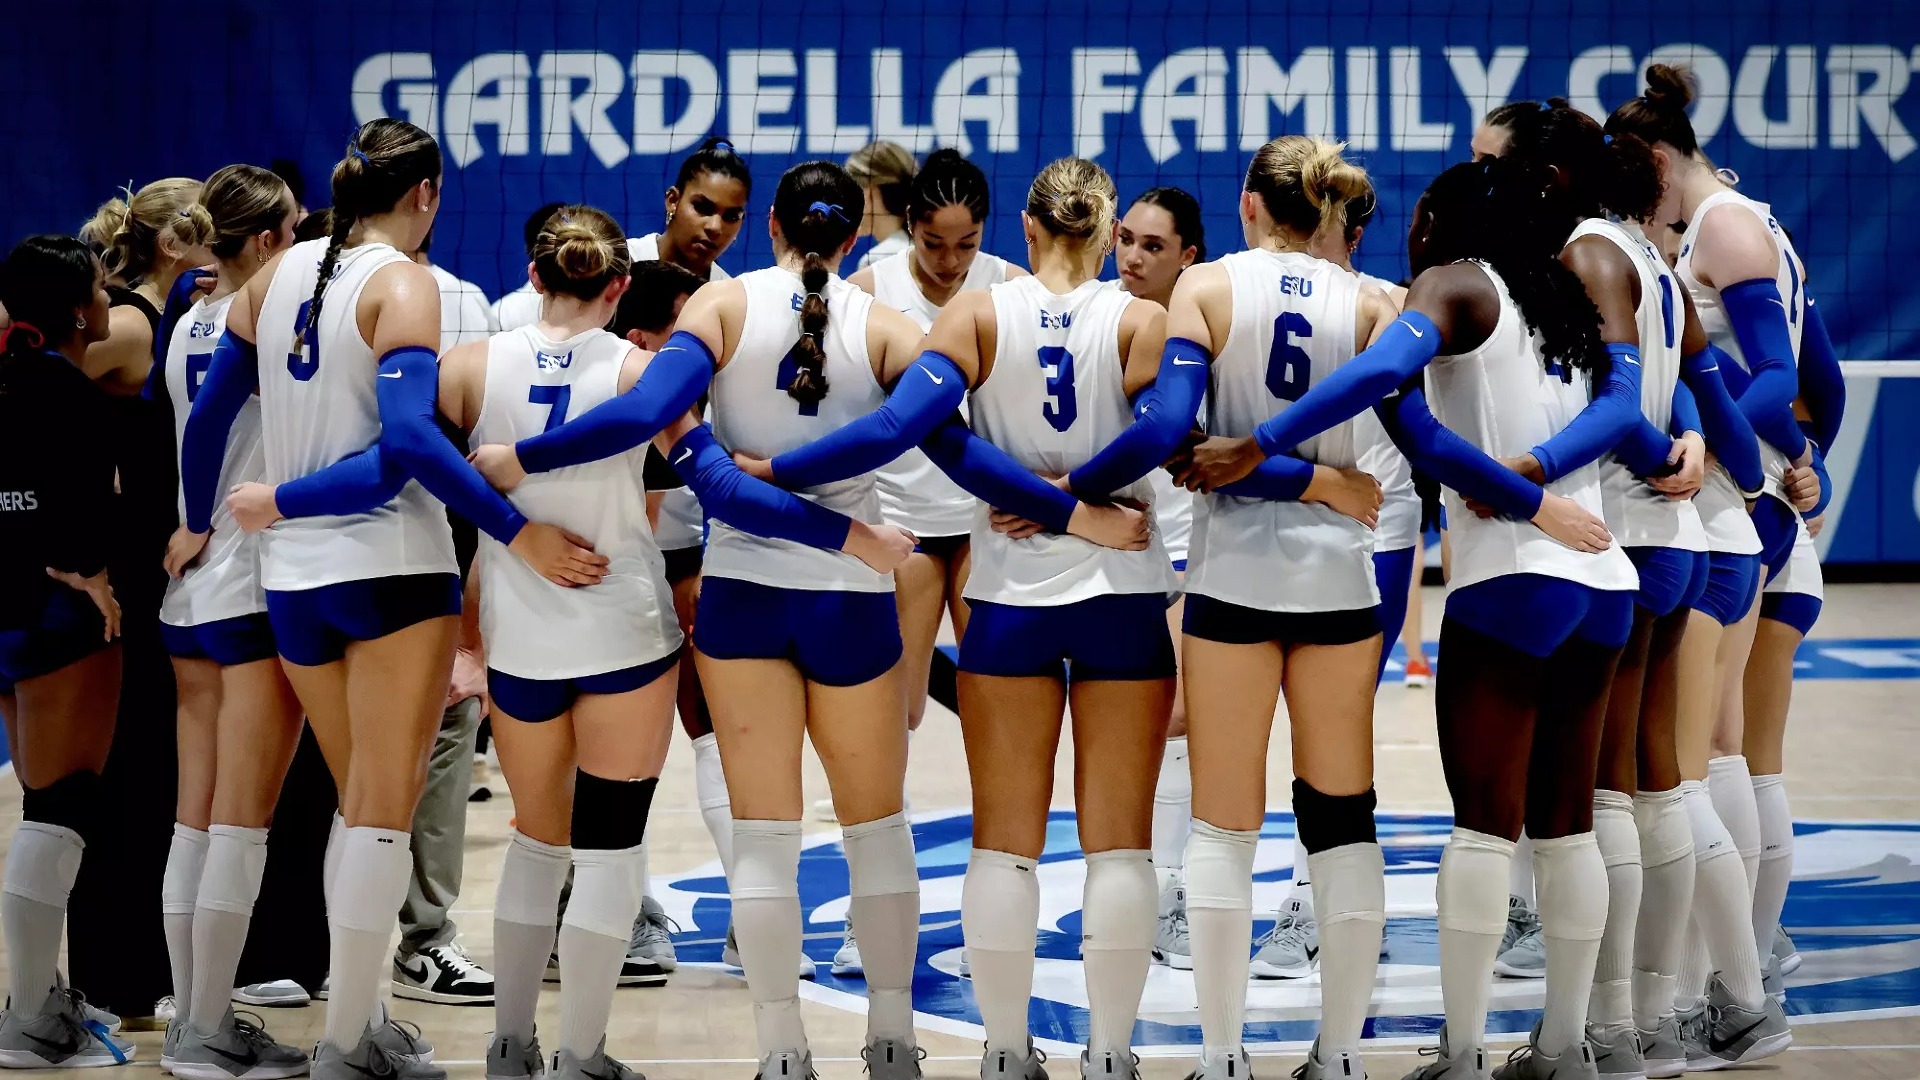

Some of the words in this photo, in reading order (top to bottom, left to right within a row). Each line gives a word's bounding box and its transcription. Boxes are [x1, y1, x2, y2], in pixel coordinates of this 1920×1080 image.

[351, 47, 1022, 169] GARDELLA
[1071, 46, 1529, 164] FAMILY
[1569, 43, 1920, 164] COUR
[1037, 345, 1078, 433] 3
[1265, 310, 1313, 403] 6
[528, 384, 571, 434] 7
